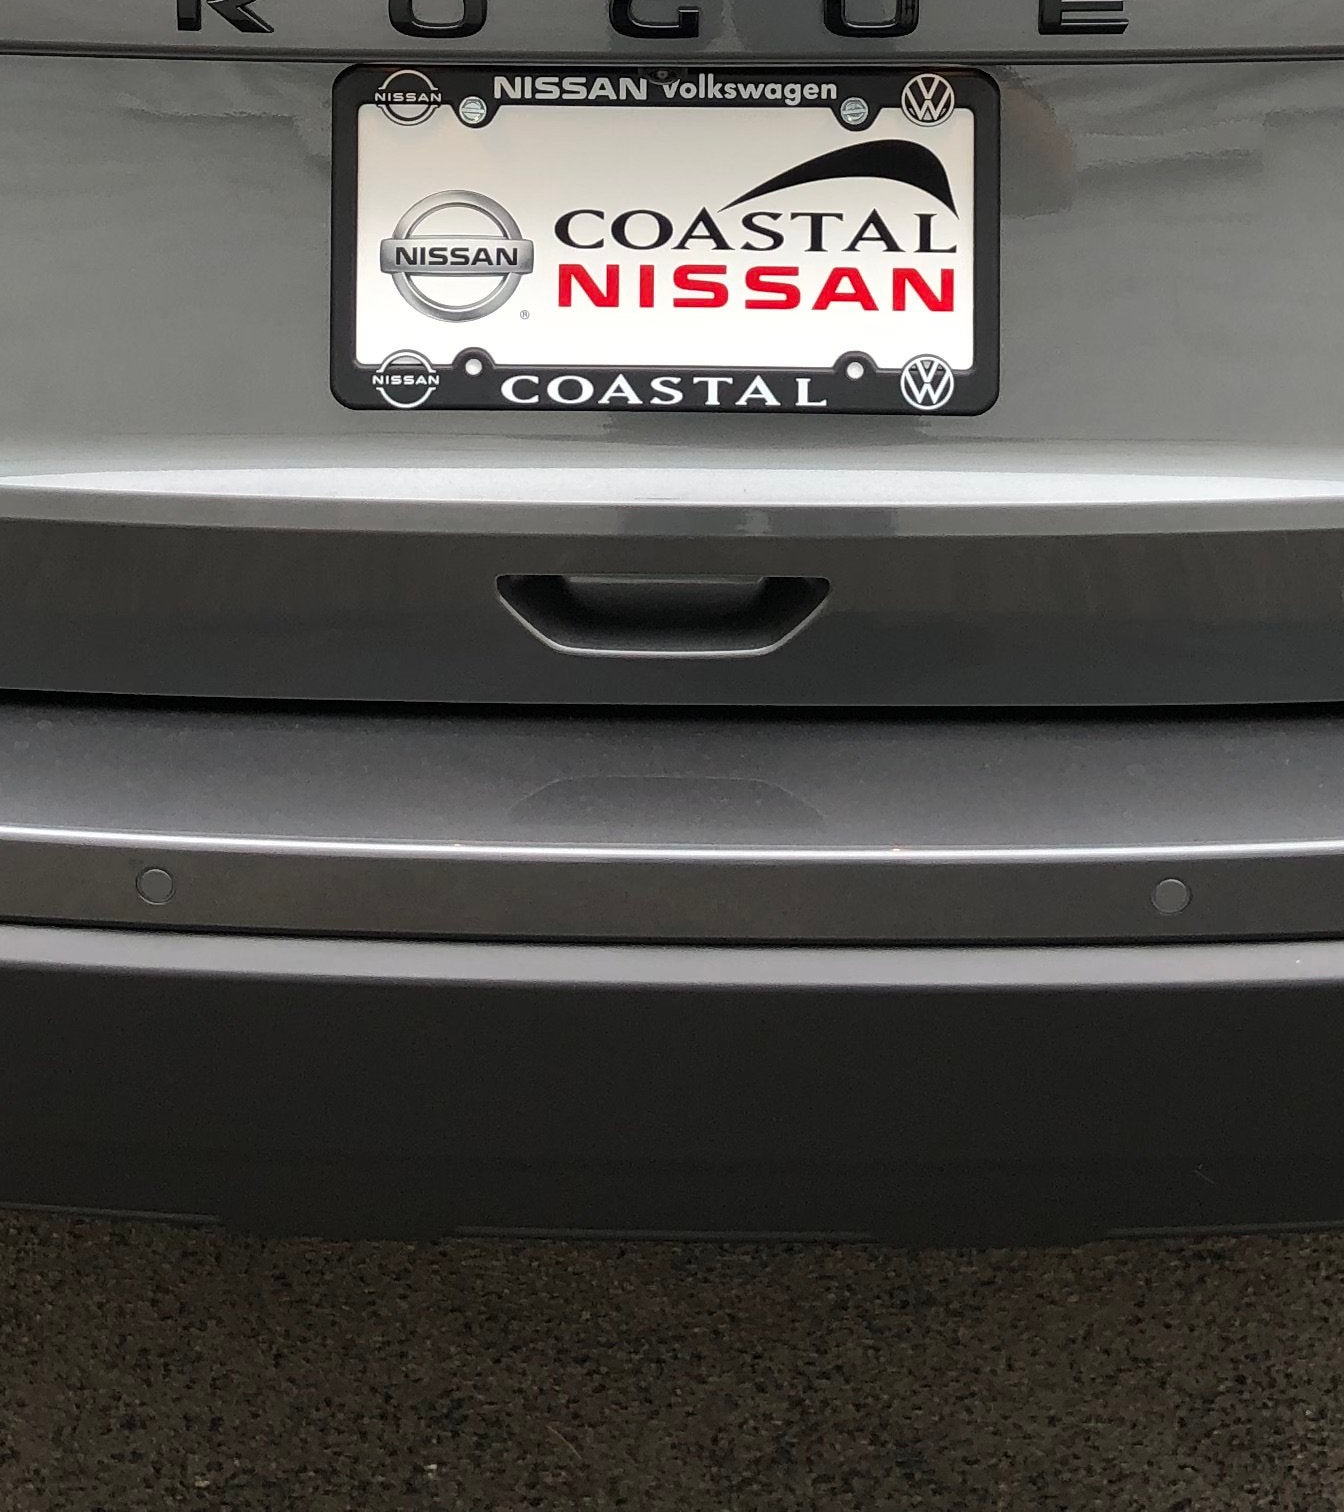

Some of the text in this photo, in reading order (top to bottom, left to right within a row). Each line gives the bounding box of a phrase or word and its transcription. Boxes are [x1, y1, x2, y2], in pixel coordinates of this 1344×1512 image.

[374, 91, 442, 103] NISSAN
[493, 73, 838, 106] NISSAN Volkswagen
[554, 206, 958, 254] COASTAL
[395, 246, 519, 267] NISSAN
[558, 263, 955, 312] NISSAN
[371, 374, 441, 386] NISSAN
[500, 373, 828, 407] COASTAL
